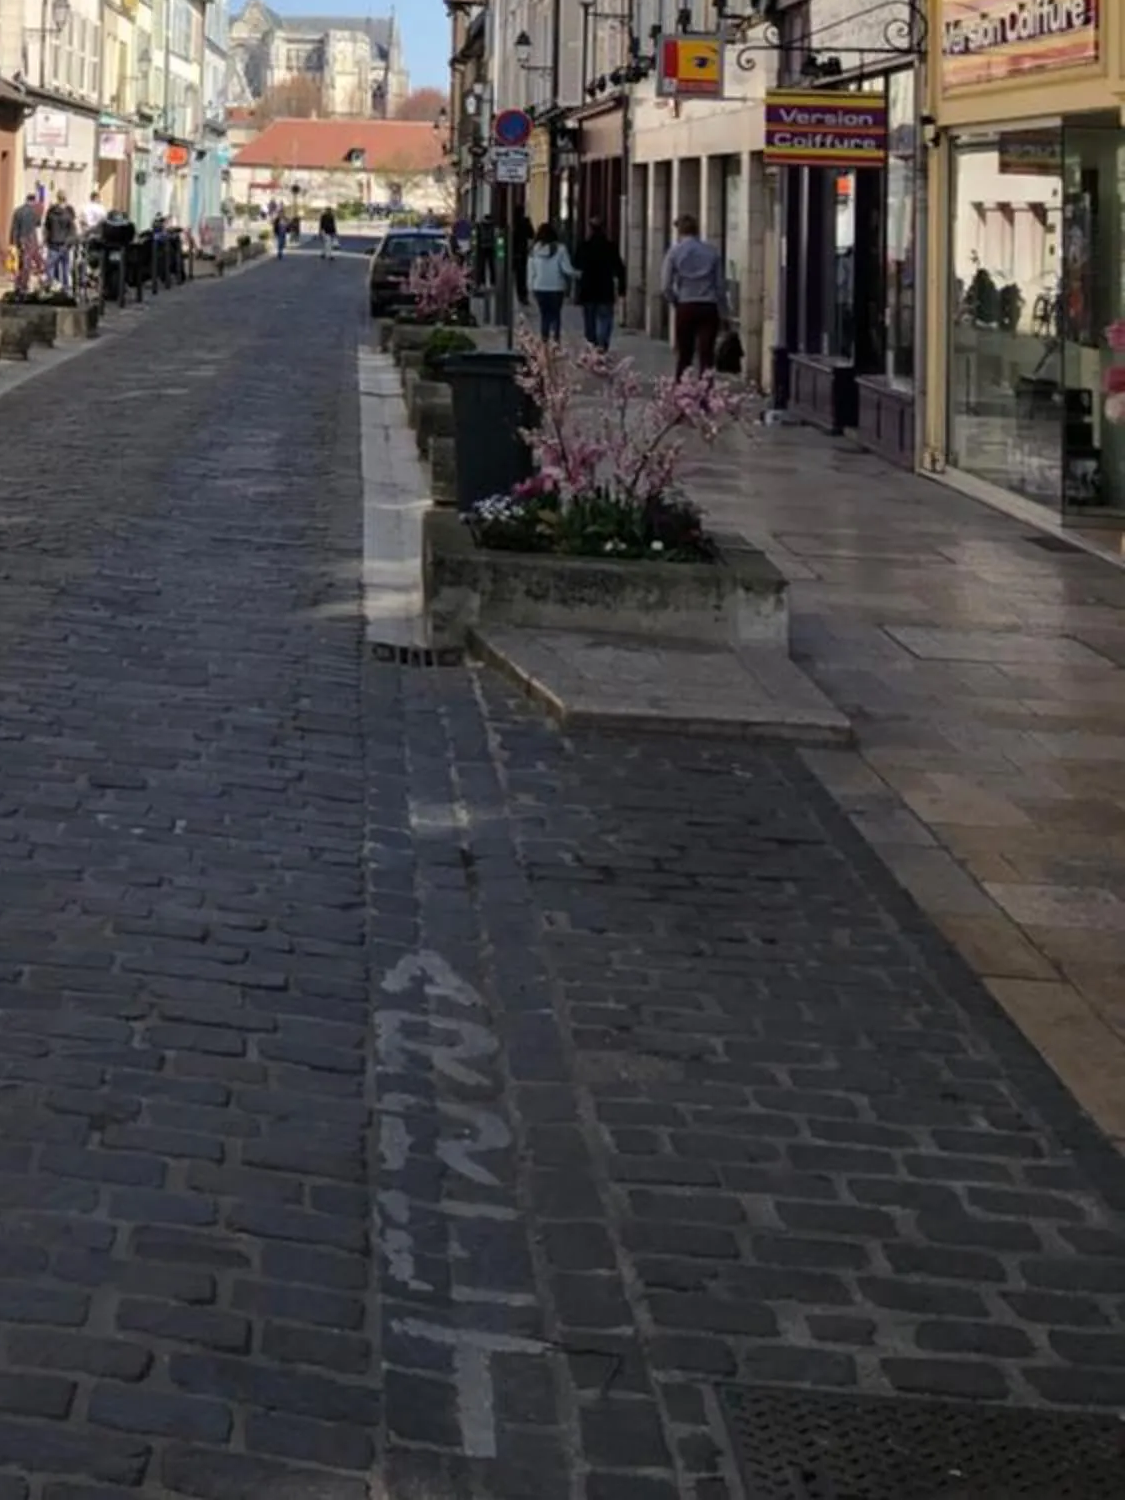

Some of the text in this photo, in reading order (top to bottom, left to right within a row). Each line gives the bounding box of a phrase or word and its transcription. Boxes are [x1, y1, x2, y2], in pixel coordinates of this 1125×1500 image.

[943, 13, 1006, 55] Version
[779, 108, 873, 127] Version
[774, 131, 876, 149] Coiffure
